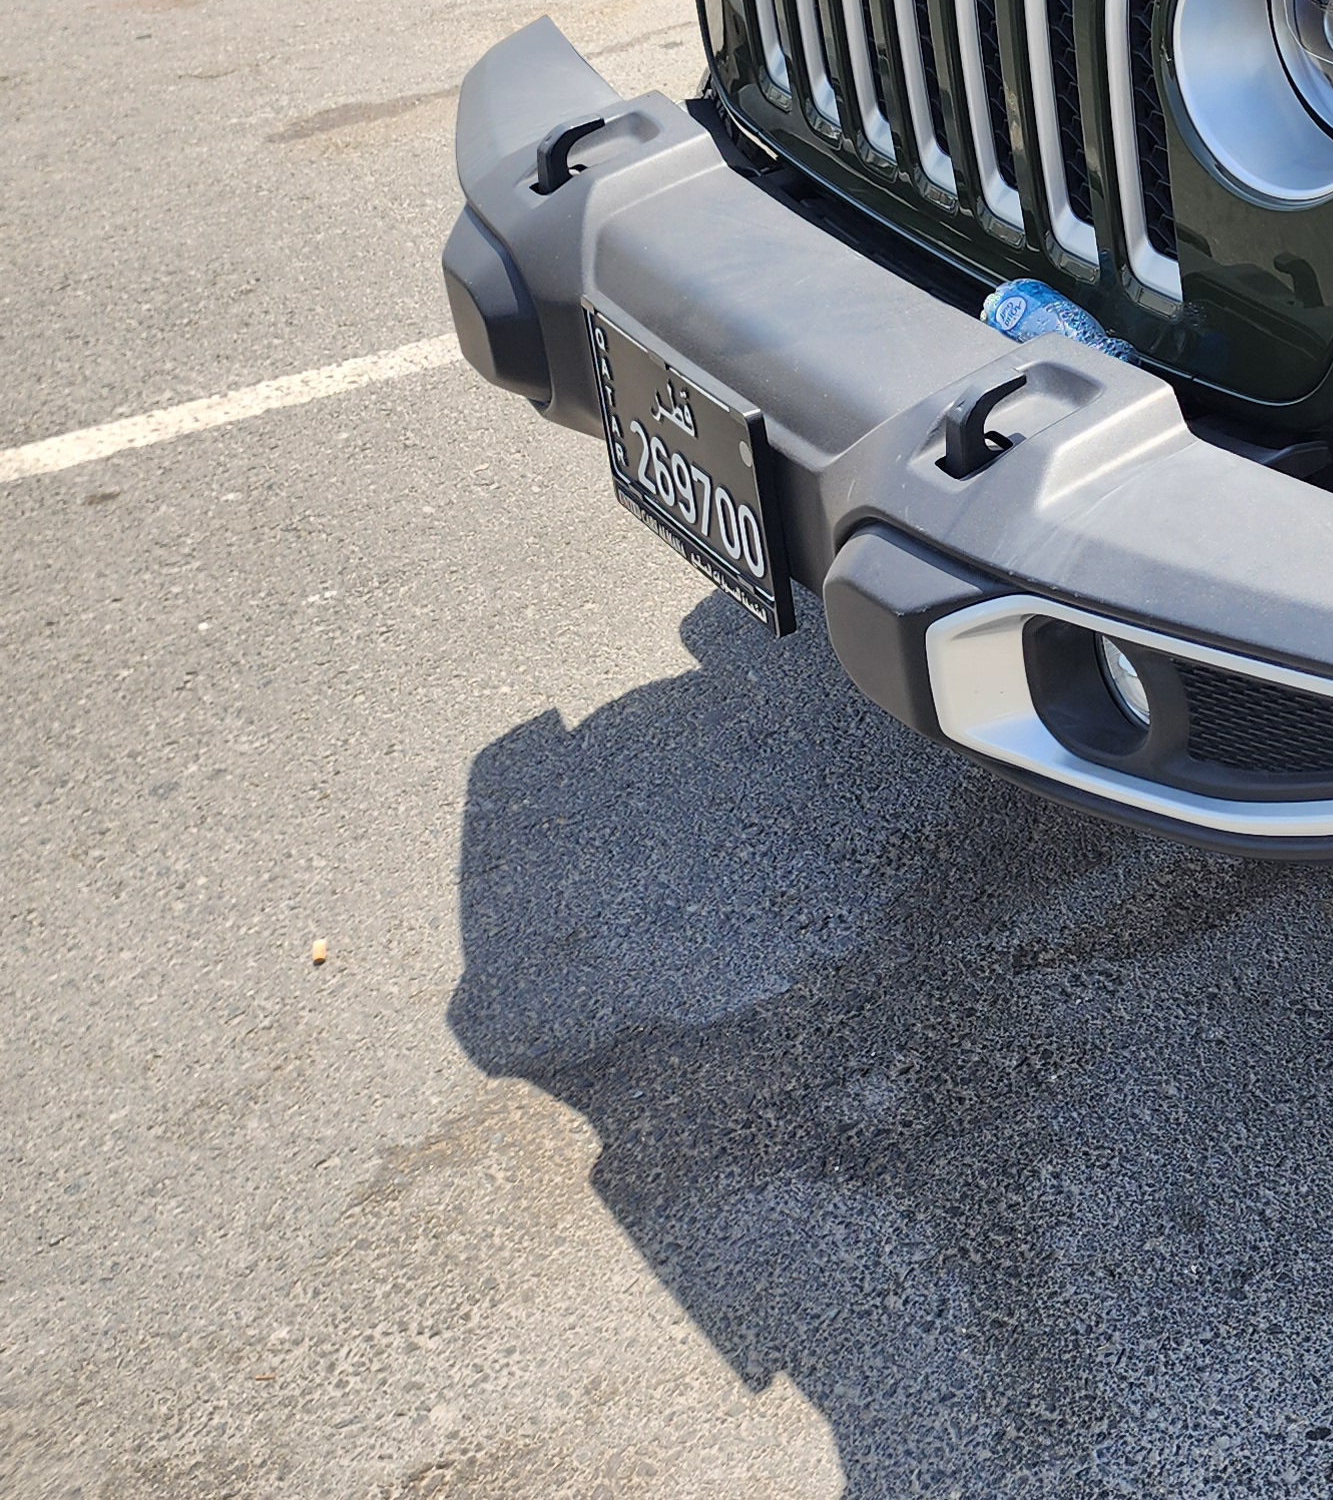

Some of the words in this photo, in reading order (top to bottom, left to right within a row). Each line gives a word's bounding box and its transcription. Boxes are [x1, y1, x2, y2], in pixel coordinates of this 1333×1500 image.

[594, 327, 628, 467] QATAR
[649, 379, 698, 439] قطر
[629, 420, 767, 580] 269700
